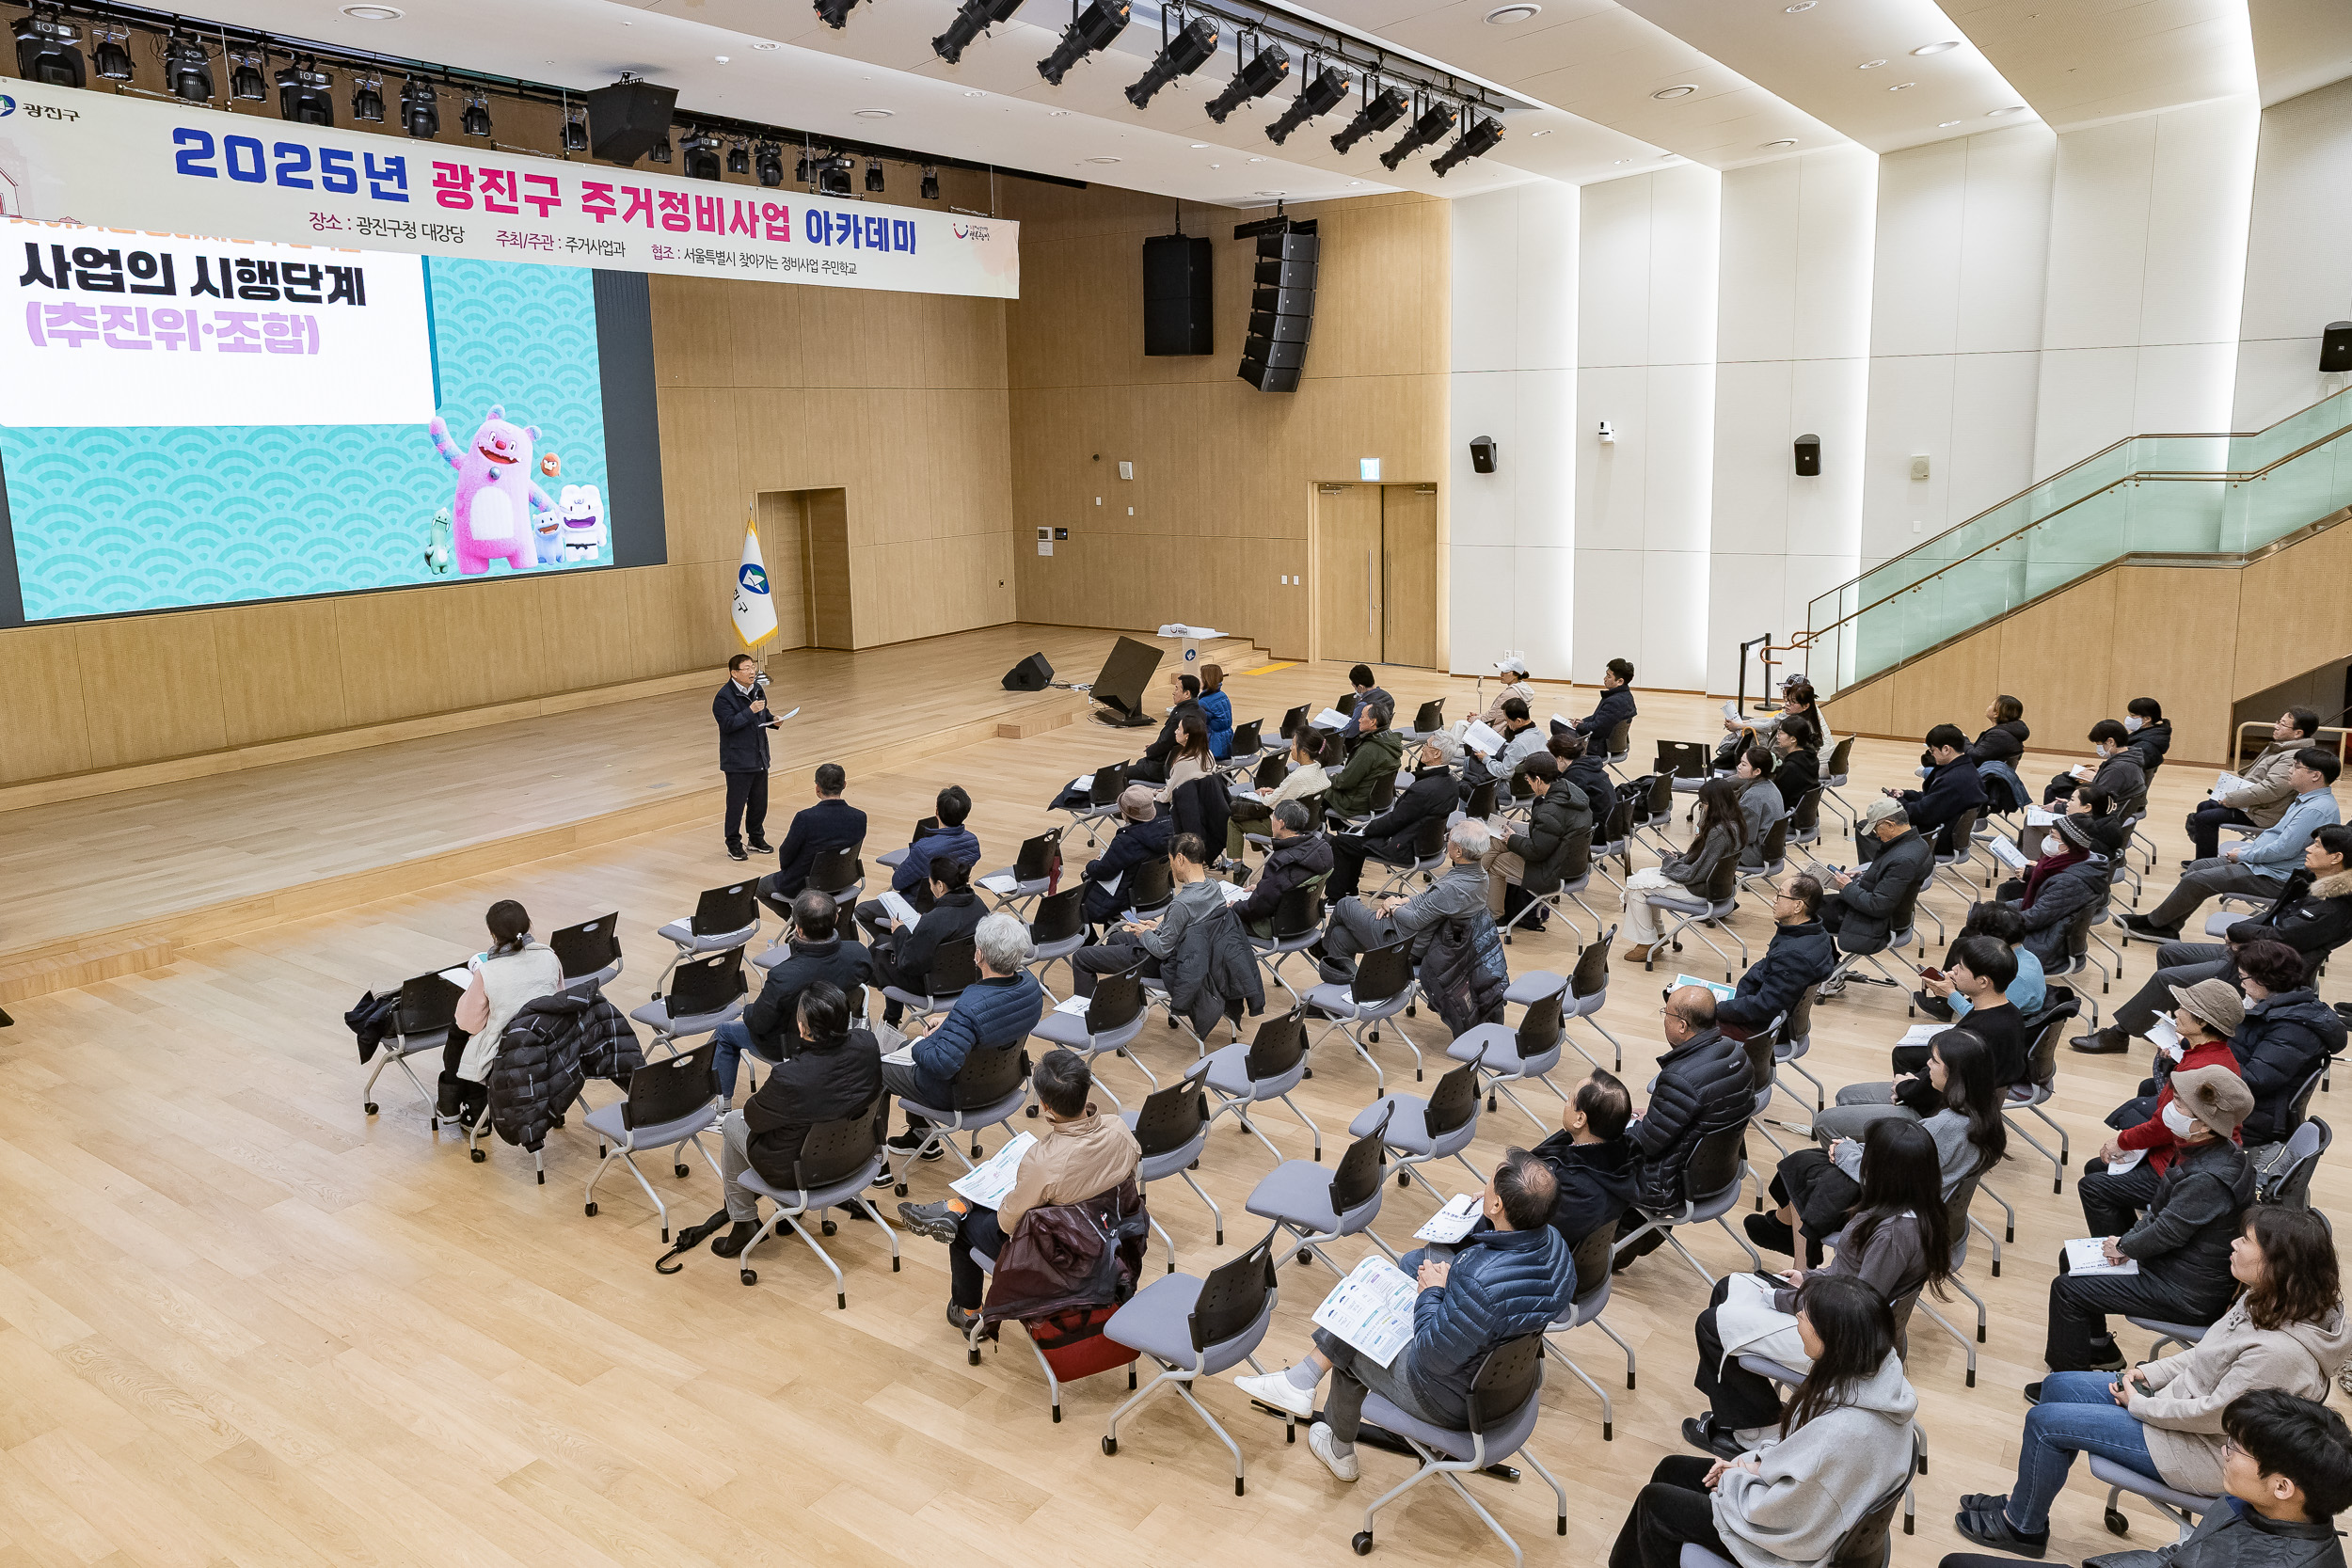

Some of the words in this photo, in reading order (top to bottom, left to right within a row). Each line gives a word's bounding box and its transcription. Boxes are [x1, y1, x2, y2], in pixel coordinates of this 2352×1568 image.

[23, 103, 81, 122] 광진구
[172, 127, 410, 203] 2025년
[432, 161, 562, 218] 광진구
[581, 181, 790, 243] 주거정비사업
[805, 209, 916, 255] 아카데미
[309, 212, 343, 231] 장소
[356, 216, 418, 239] 광진구청
[421, 224, 466, 245] 대강당
[496, 230, 555, 252] 주최/주관
[564, 237, 627, 258] 주거사업과
[19, 242, 176, 296] 사업의
[189, 255, 367, 307] 시행단계
[651, 244, 675, 261] 협조
[684, 247, 737, 267] 서울특별시
[739, 252, 779, 270] 찾아가는
[781, 256, 819, 274] 정비사업
[820, 261, 858, 277] 주민학교
